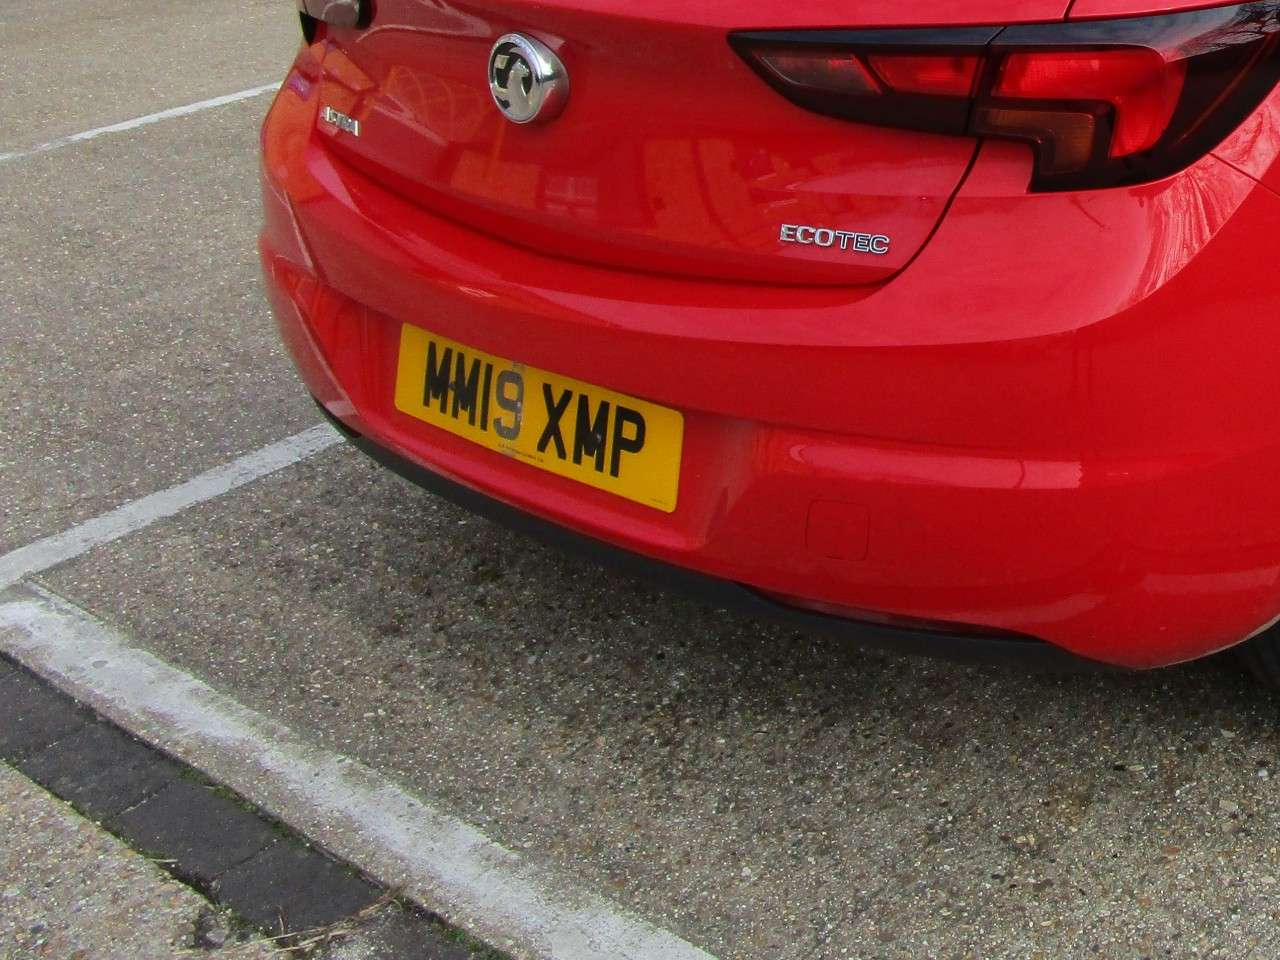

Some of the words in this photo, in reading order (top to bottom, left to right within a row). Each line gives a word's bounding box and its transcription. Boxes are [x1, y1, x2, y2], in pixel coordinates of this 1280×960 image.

[779, 223, 890, 254] ECOTEC
[422, 340, 525, 441] MM19
[536, 382, 647, 478] XMP
